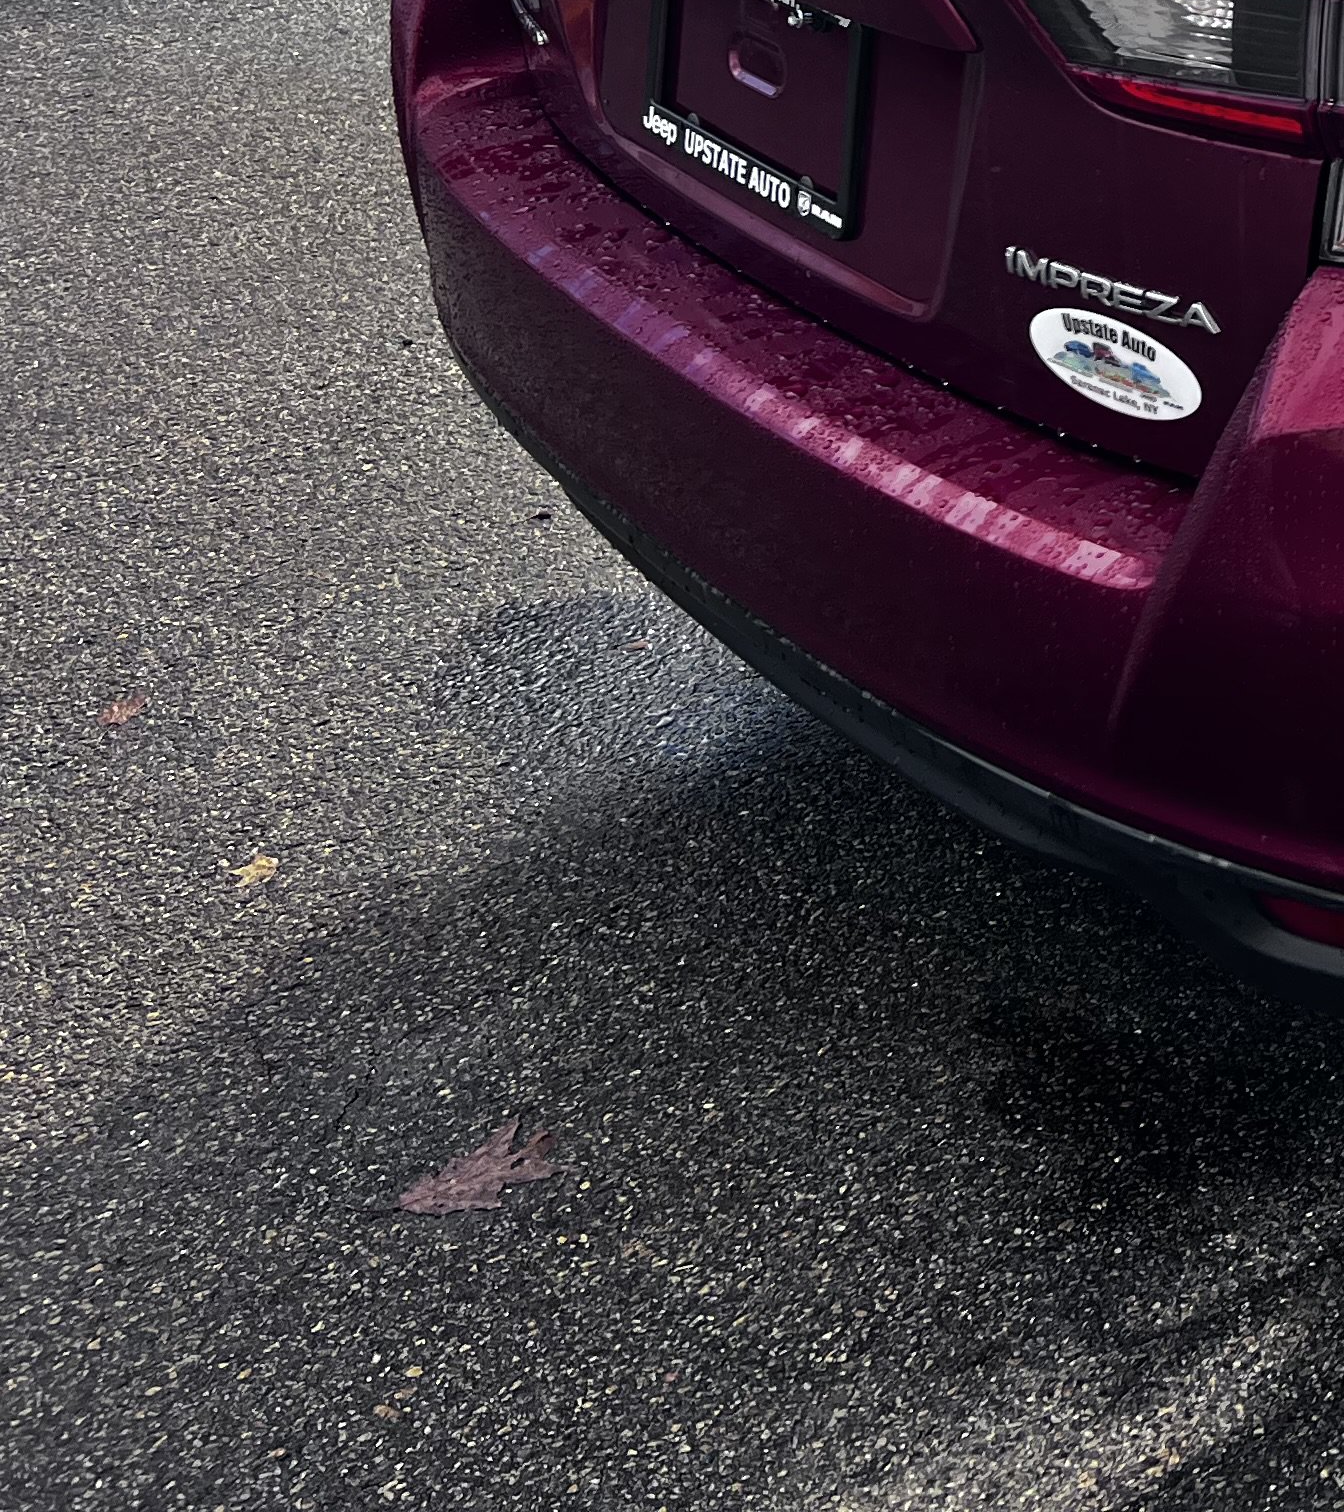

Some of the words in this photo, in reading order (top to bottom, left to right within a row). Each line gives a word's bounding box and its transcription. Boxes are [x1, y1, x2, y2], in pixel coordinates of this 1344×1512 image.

[642, 105, 677, 145] Jeep
[683, 128, 747, 184] UPSTATE
[748, 166, 790, 209] AUTO
[1005, 246, 1221, 334] IMPREZA
[1061, 312, 1118, 344] Upstate
[1121, 331, 1156, 362] Auto
